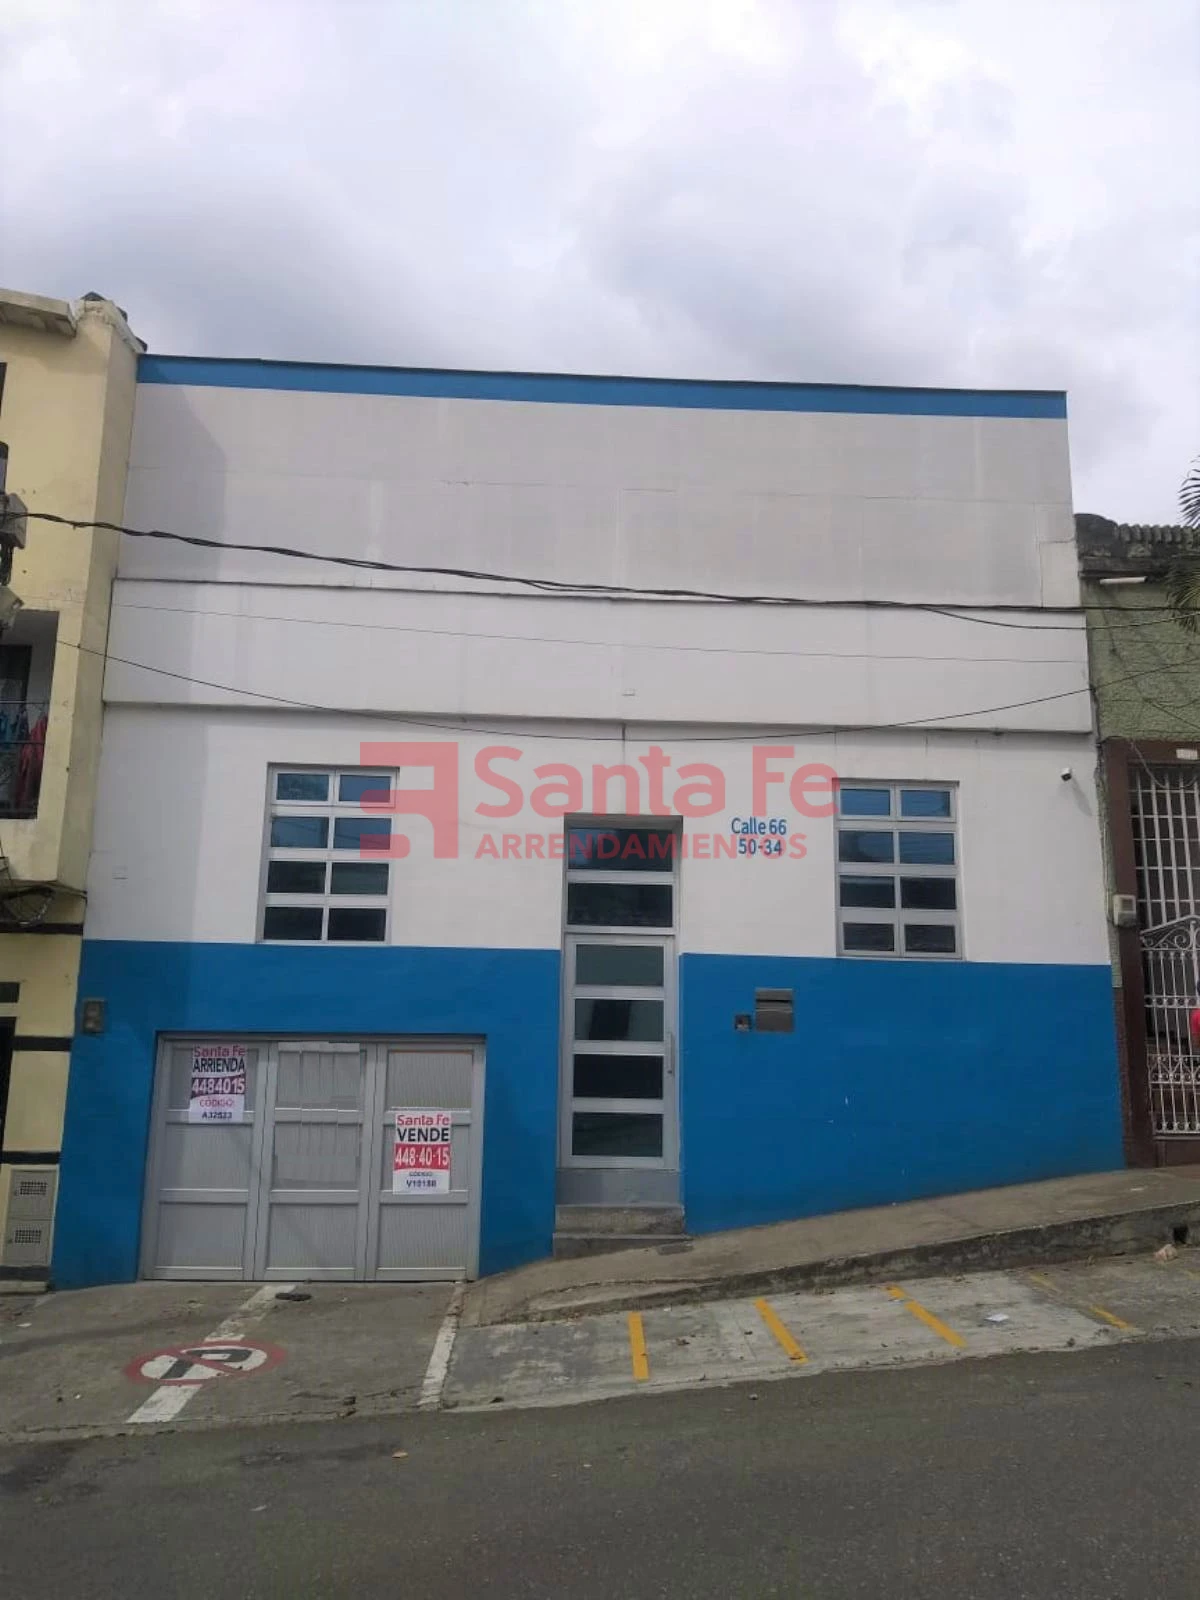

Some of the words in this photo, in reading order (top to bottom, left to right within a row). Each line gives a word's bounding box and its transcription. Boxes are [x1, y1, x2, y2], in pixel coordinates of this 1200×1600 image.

[731, 816, 766, 835] Calle
[769, 818, 787, 835] 66
[738, 838, 782, 856] 50-34
[194, 1046, 230, 1057] Santa
[232, 1045, 245, 1056] Fe
[192, 1057, 245, 1072] ARRIENDA
[191, 1078, 245, 1094] 4484015
[397, 1114, 433, 1126] Santa
[436, 1113, 450, 1126] Fe
[397, 1127, 450, 1142] VENDE
